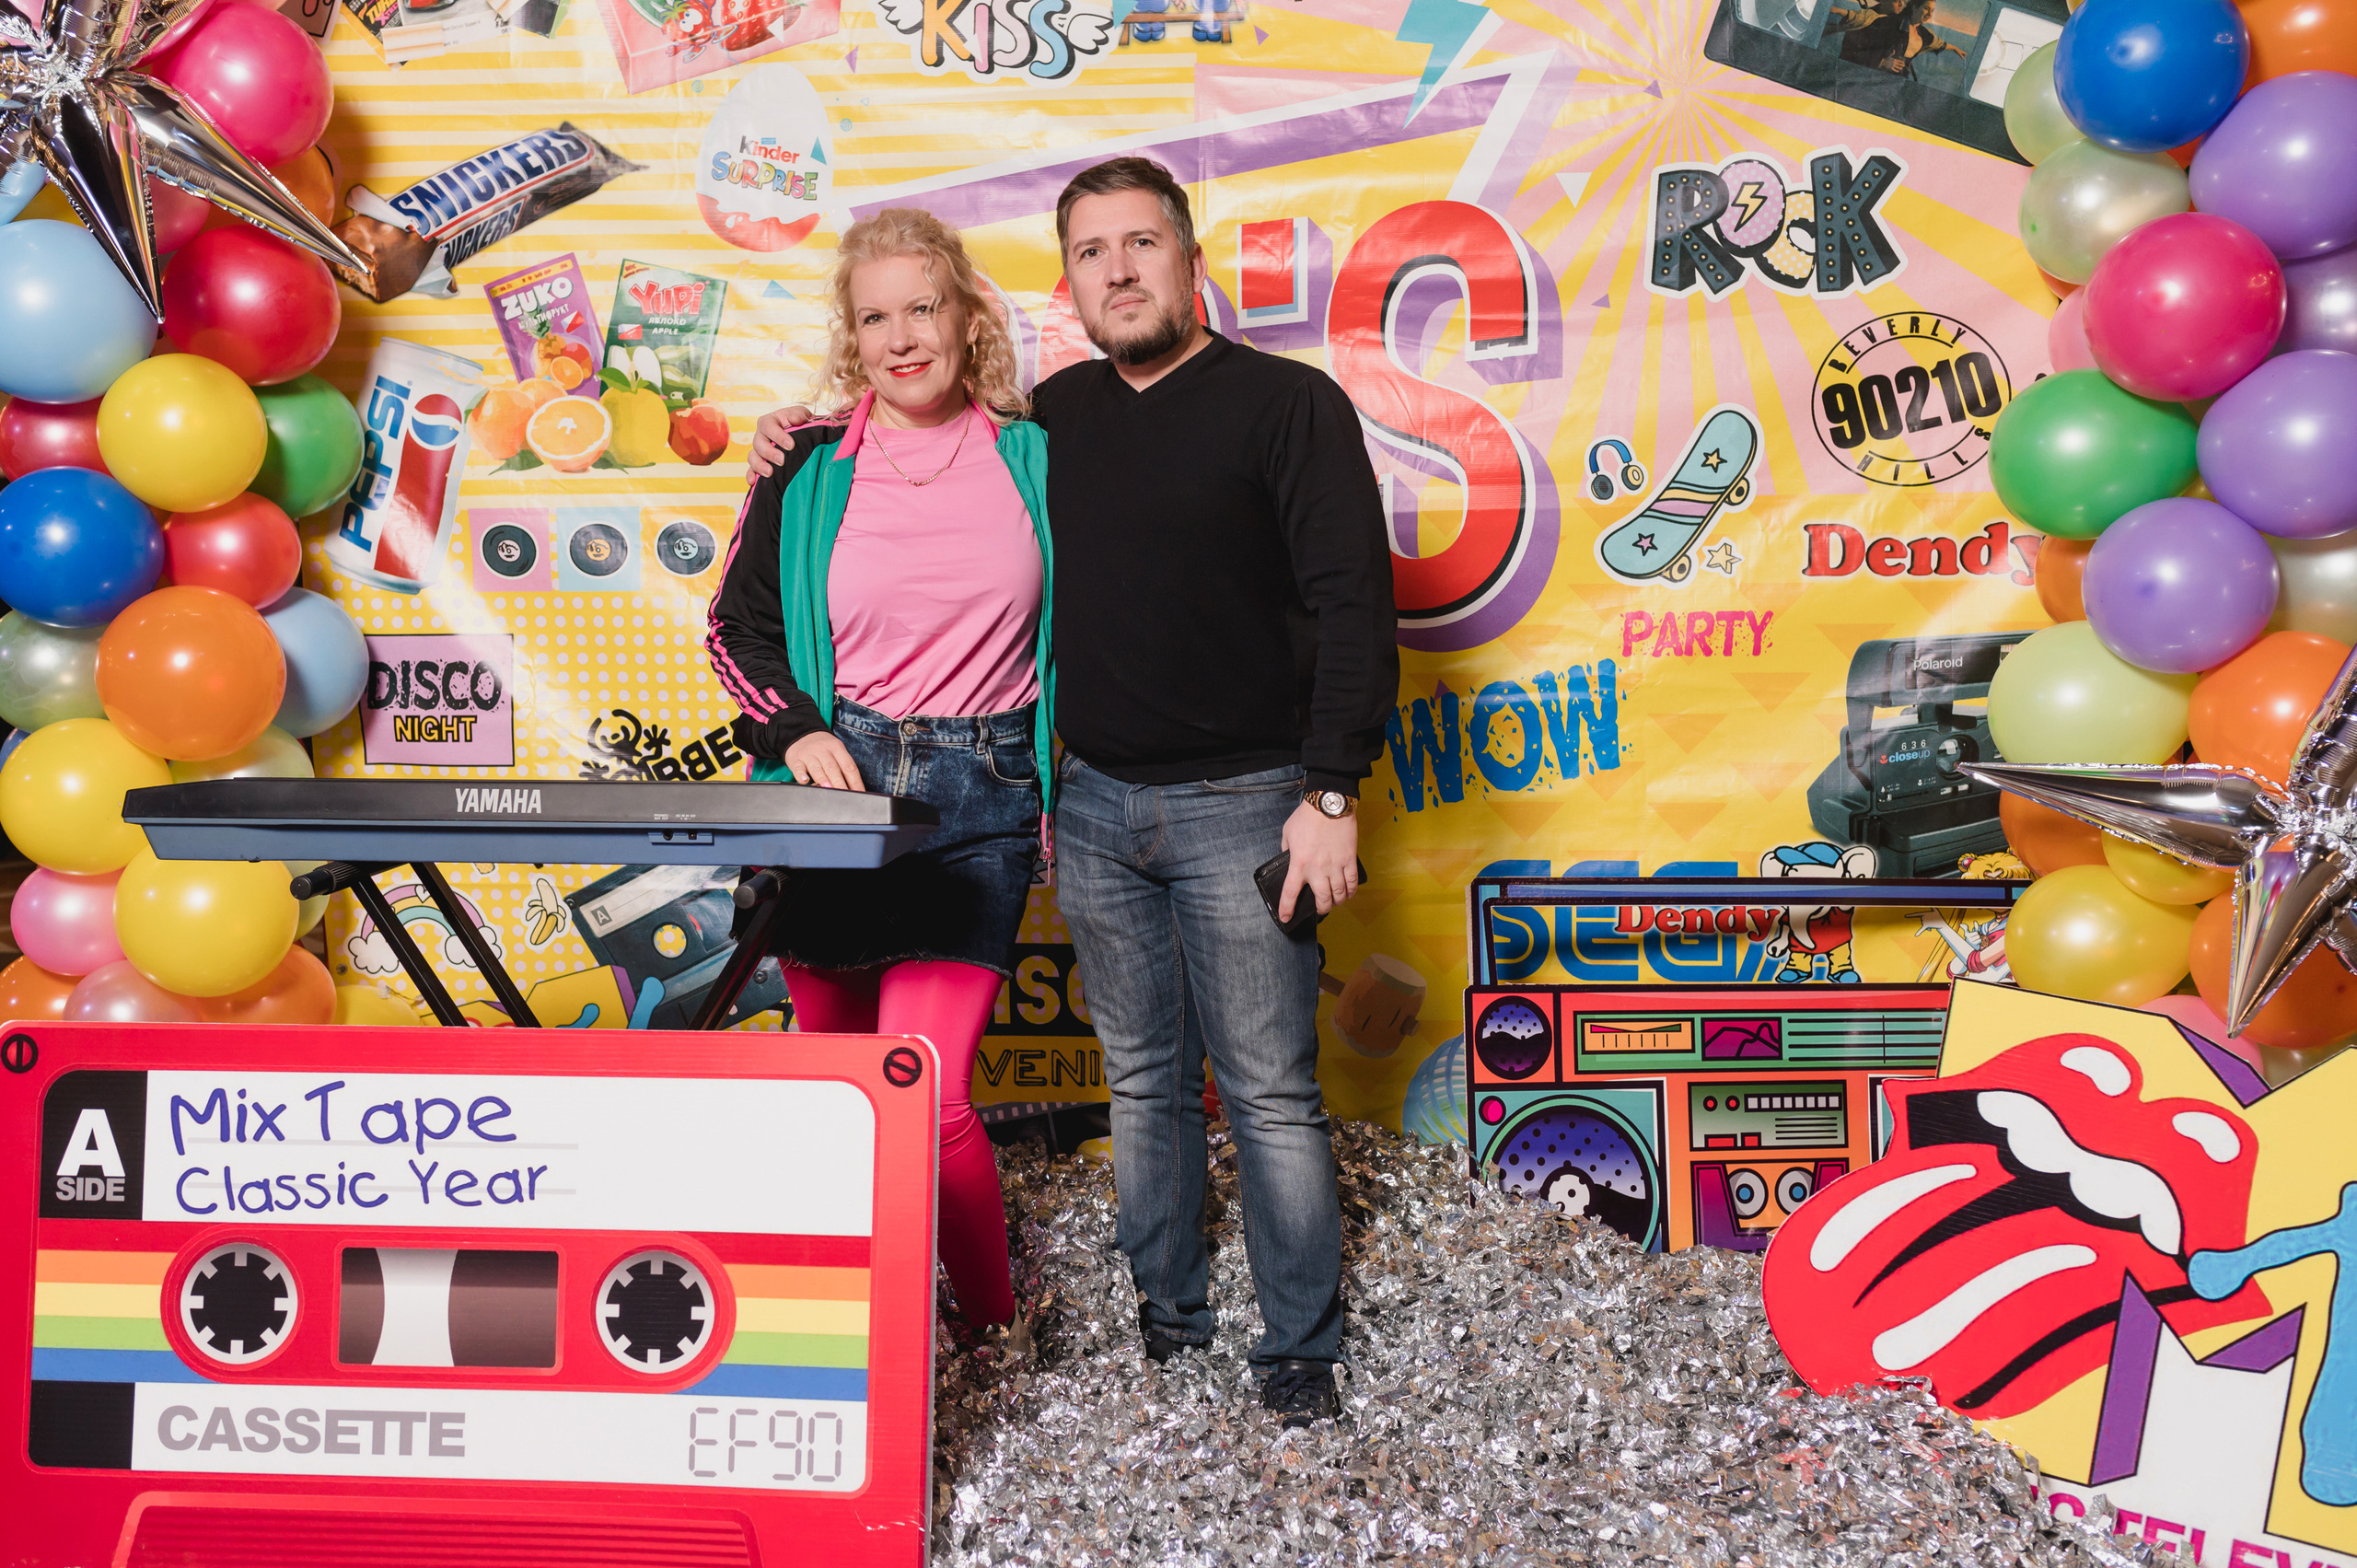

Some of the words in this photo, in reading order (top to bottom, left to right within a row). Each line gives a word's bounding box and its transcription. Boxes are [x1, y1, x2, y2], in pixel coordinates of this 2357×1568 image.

[389, 130, 587, 235] SNICKERS
[712, 151, 819, 201] SURPRISE
[1651, 152, 1901, 296] ROCK
[501, 277, 573, 320] ZUKO
[1828, 316, 1967, 372] BEVERLY
[1821, 352, 2003, 449] 90210
[340, 375, 411, 552] PEPSI
[1802, 521, 2047, 587] Dendy
[1620, 610, 1774, 658] PARTY
[367, 660, 503, 712] DISCO
[1913, 656, 1963, 670] Polaroid
[393, 715, 478, 742] NIGHT
[1386, 658, 1620, 813] WOW
[455, 788, 541, 814] YAMAHA
[1615, 905, 1782, 942] Dendy
[56, 1109, 126, 1177] A
[170, 1087, 287, 1156] Mix
[56, 1177, 125, 1202] SIDE
[176, 1161, 389, 1215] Classic
[408, 1158, 548, 1206] Year
[157, 1405, 467, 1458] CASSETTE
[688, 1406, 845, 1481] EF90
